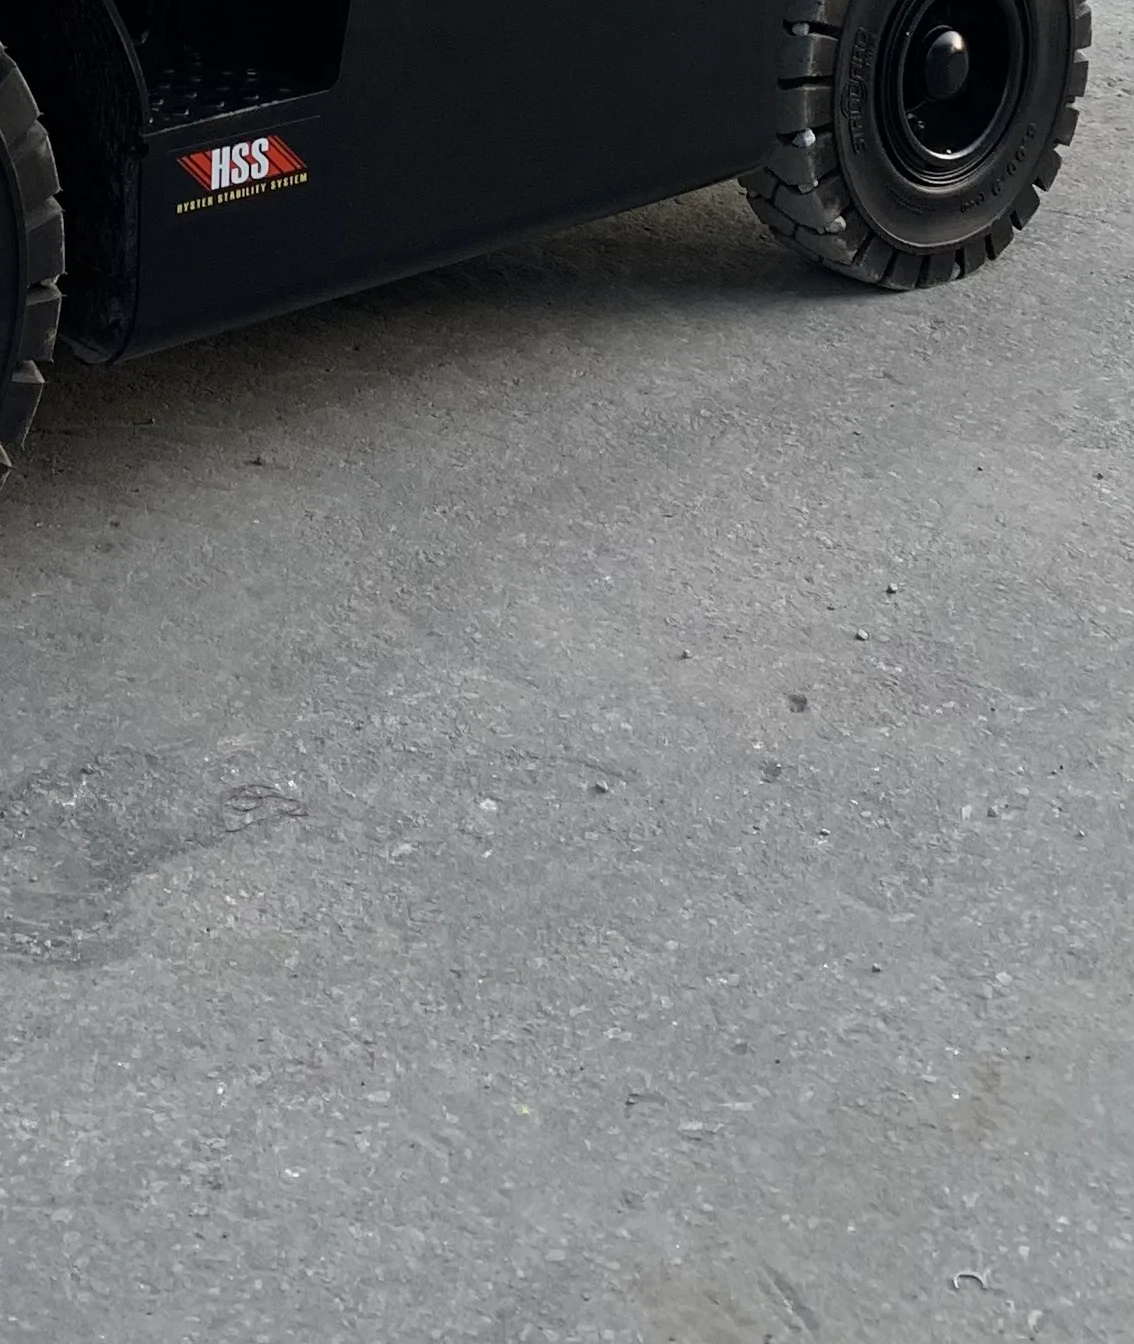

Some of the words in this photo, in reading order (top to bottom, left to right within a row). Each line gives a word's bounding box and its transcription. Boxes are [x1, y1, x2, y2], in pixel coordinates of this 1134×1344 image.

[210, 137, 270, 191] HSS
[176, 196, 214, 214] HYSTER
[217, 183, 267, 204] STABILITY
[270, 173, 308, 190] SYSTEM
